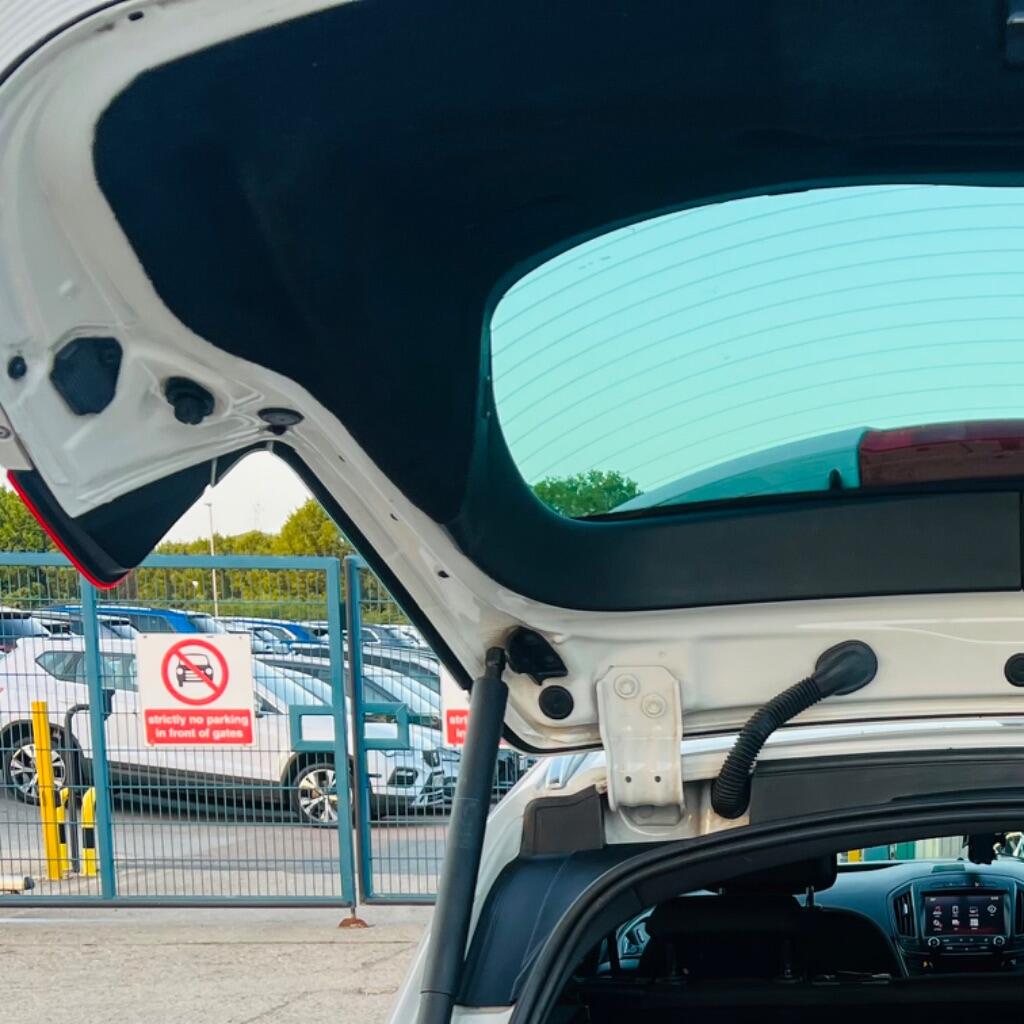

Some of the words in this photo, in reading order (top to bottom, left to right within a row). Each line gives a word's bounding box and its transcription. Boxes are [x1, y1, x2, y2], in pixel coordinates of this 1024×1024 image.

[148, 714, 186, 726] strictly
[188, 716, 204, 725] no
[206, 714, 249, 727] parking
[155, 728, 166, 738] in
[169, 728, 196, 738] front
[198, 728, 210, 738] of
[212, 729, 244, 740] gates
